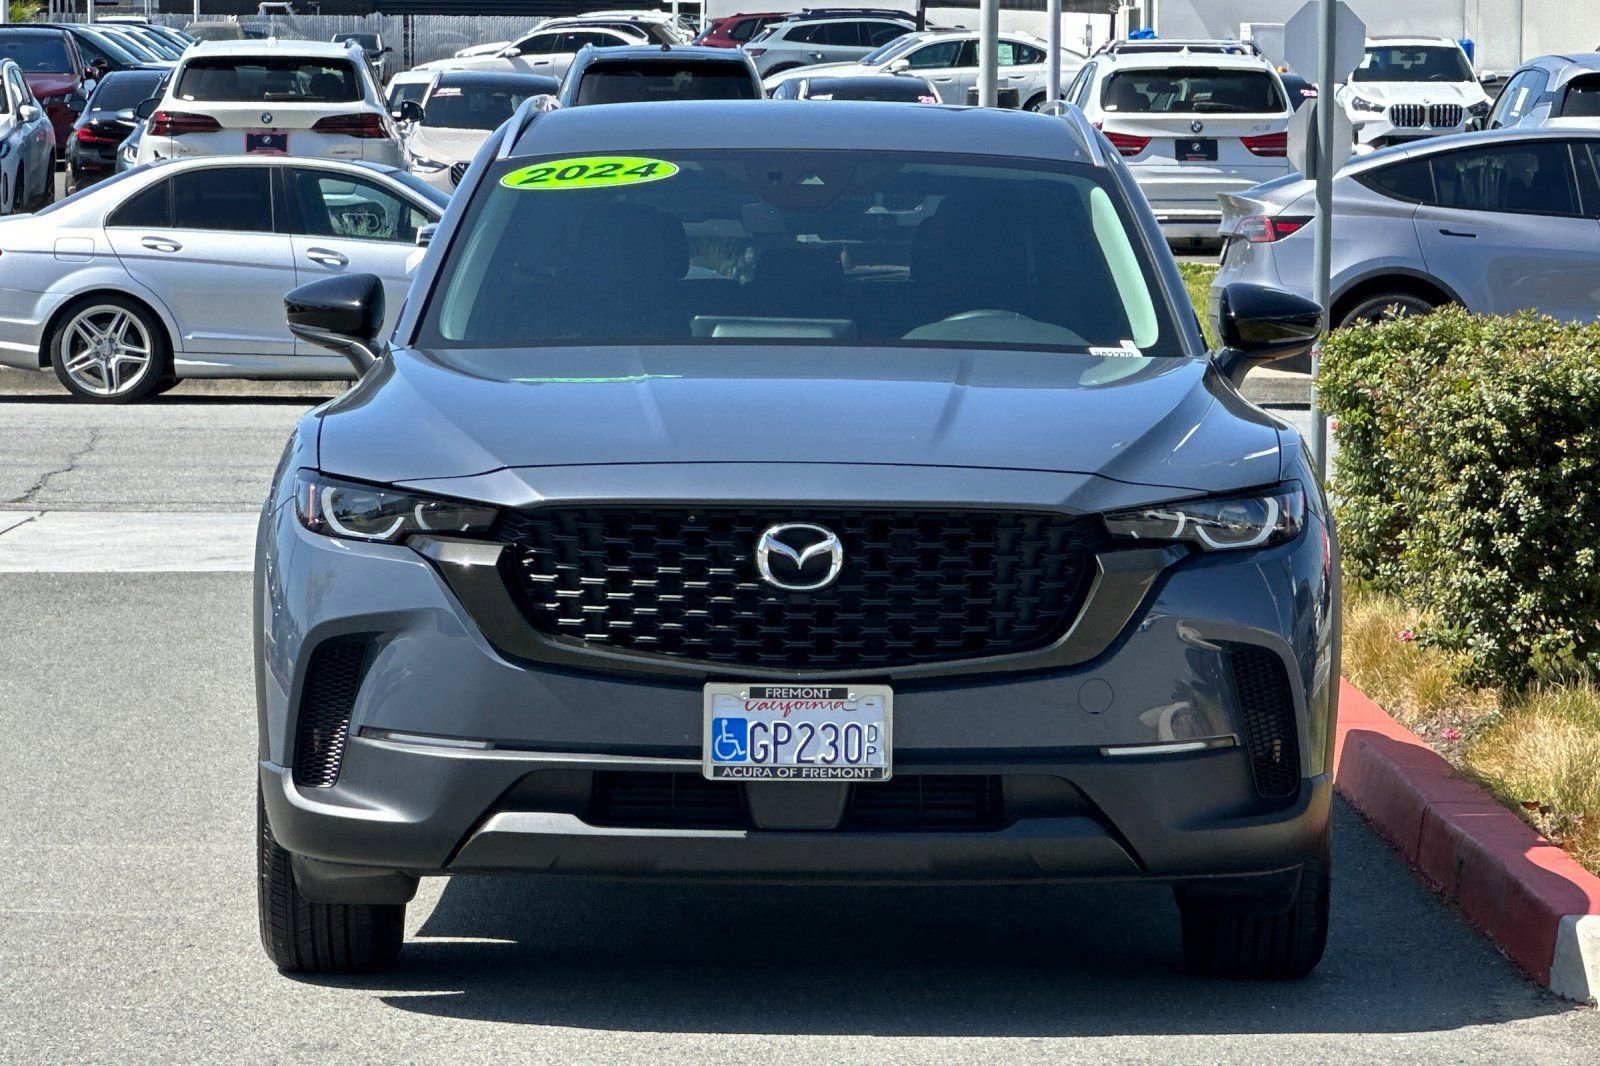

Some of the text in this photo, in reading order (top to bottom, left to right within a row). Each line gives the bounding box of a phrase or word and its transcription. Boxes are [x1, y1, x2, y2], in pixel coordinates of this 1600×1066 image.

[517, 162, 660, 185] 2024
[765, 687, 832, 699] FREMONT
[749, 722, 863, 764] GP230
[722, 767, 875, 778] ACURA OF FREMONT
